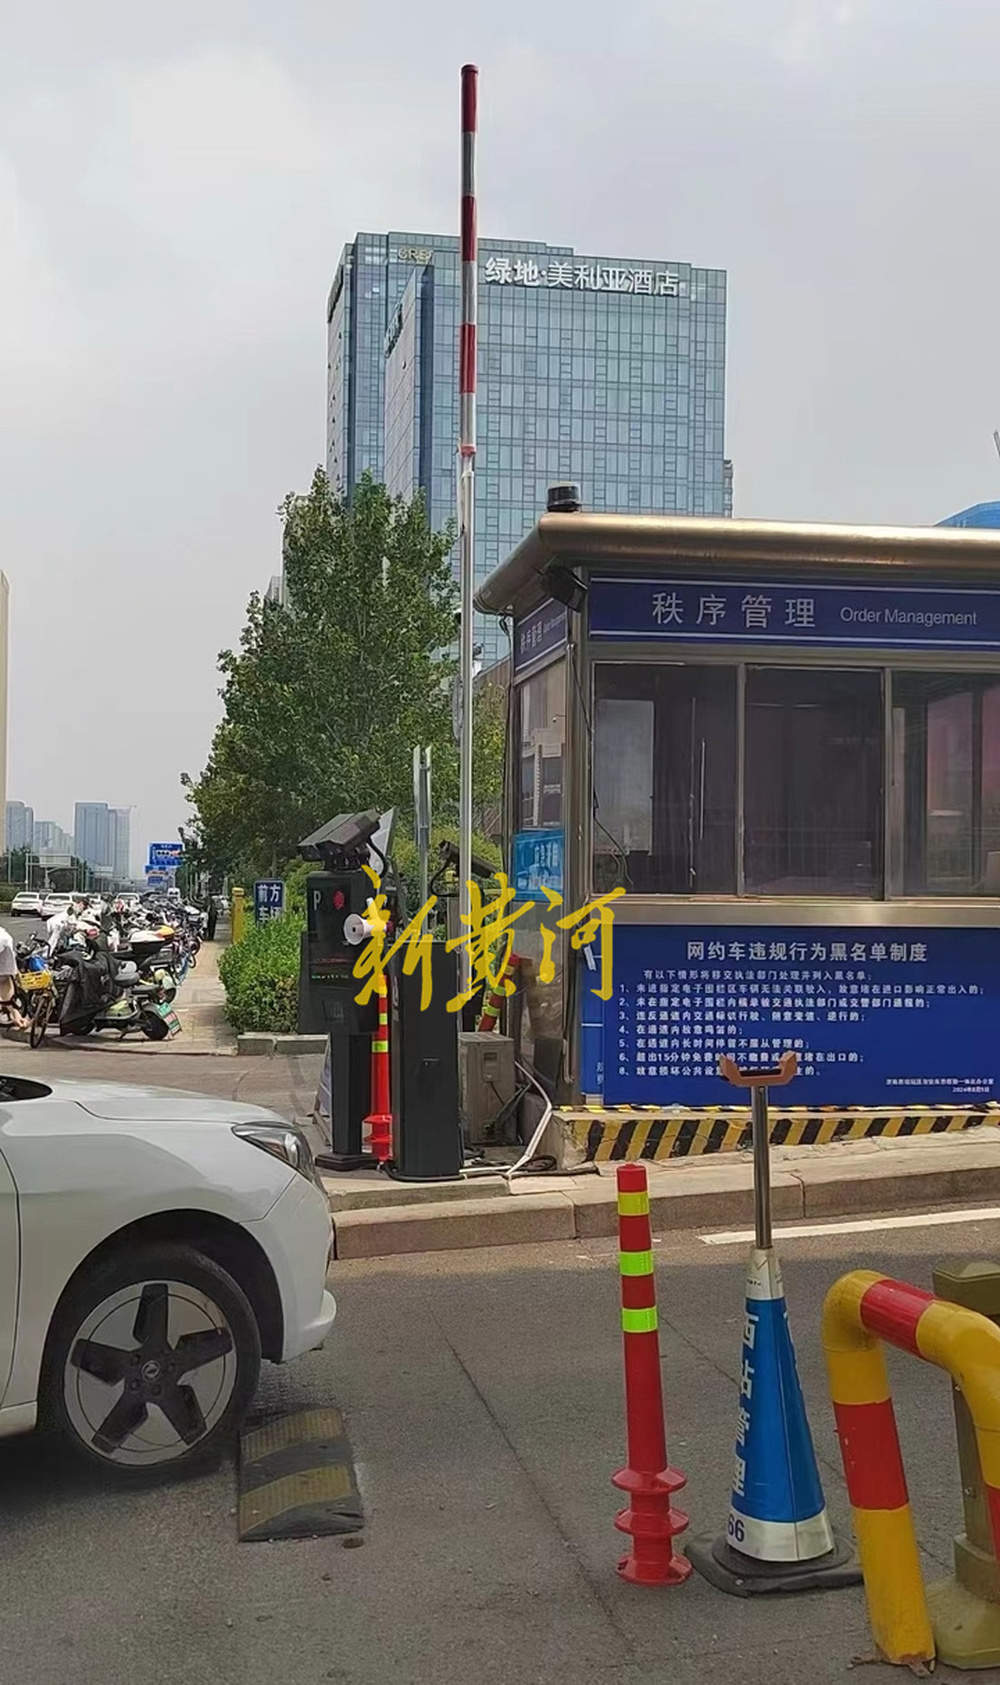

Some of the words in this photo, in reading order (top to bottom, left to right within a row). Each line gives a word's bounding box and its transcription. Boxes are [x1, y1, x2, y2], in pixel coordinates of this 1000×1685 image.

[484, 256, 680, 297] 绿地·美利亚酒店
[652, 590, 816, 629] 秩序管理
[840, 606, 881, 624] Order
[884, 608, 978, 627] Management
[257, 884, 281, 903] 前方
[686, 941, 928, 962] 网约车违规行为黑名单制度
[727, 1514, 745, 1543] 66
